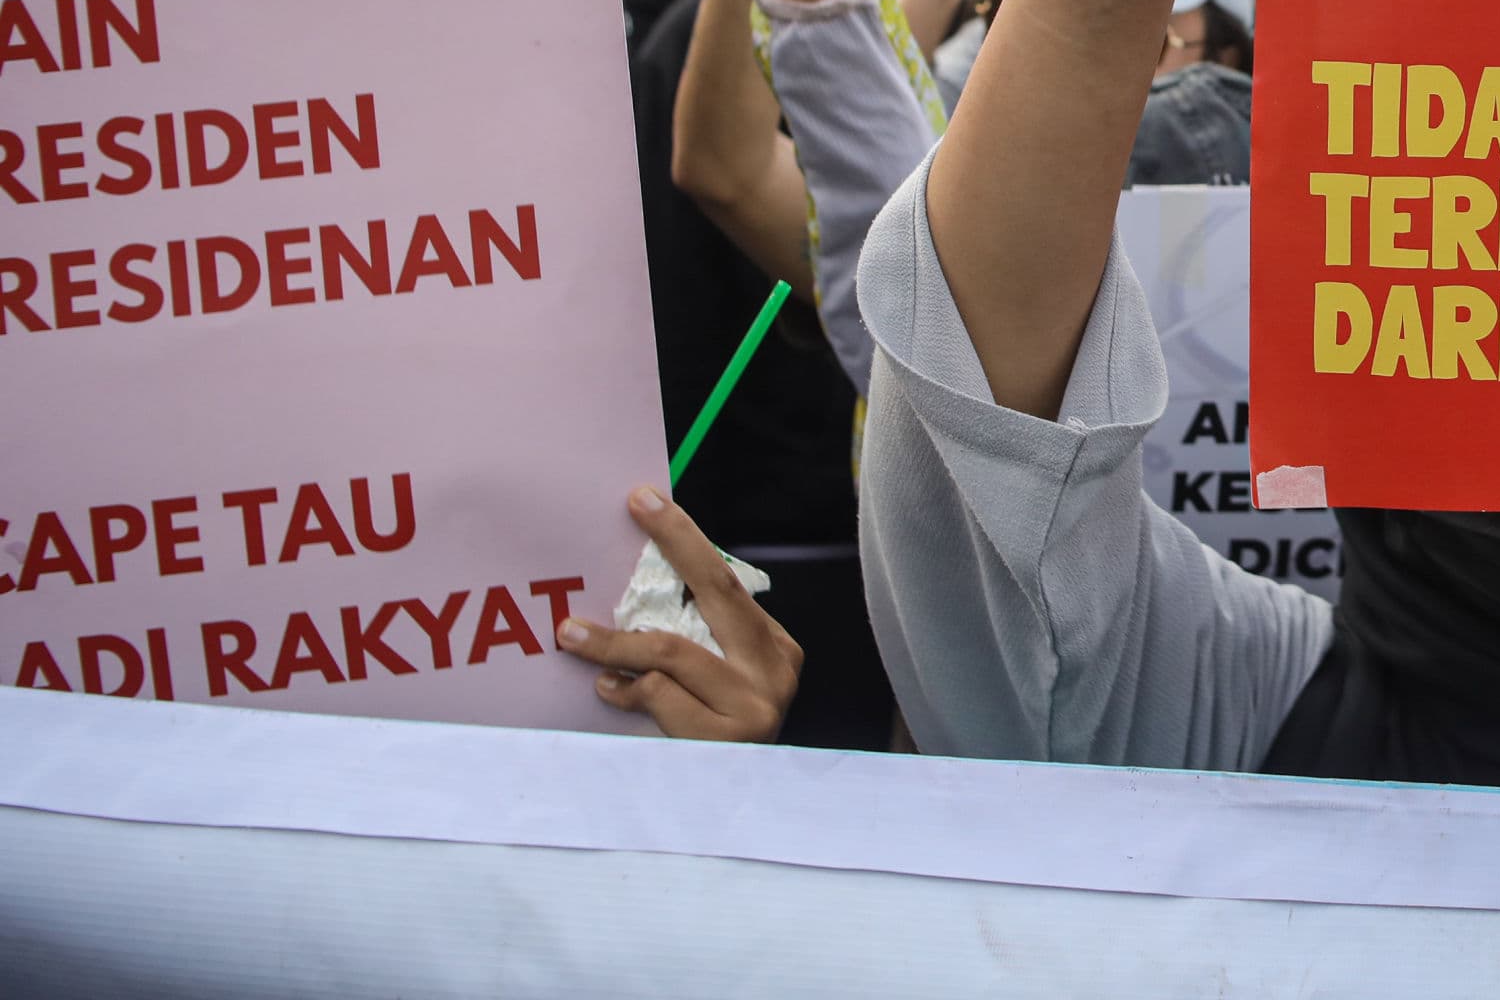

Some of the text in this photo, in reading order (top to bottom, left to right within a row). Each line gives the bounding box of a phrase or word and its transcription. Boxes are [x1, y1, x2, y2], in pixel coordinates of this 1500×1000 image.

[1182, 401, 1249, 444] A
[224, 472, 417, 567] TAU
[1229, 538, 1346, 578] DIC
[202, 577, 586, 697] RAKYAT
